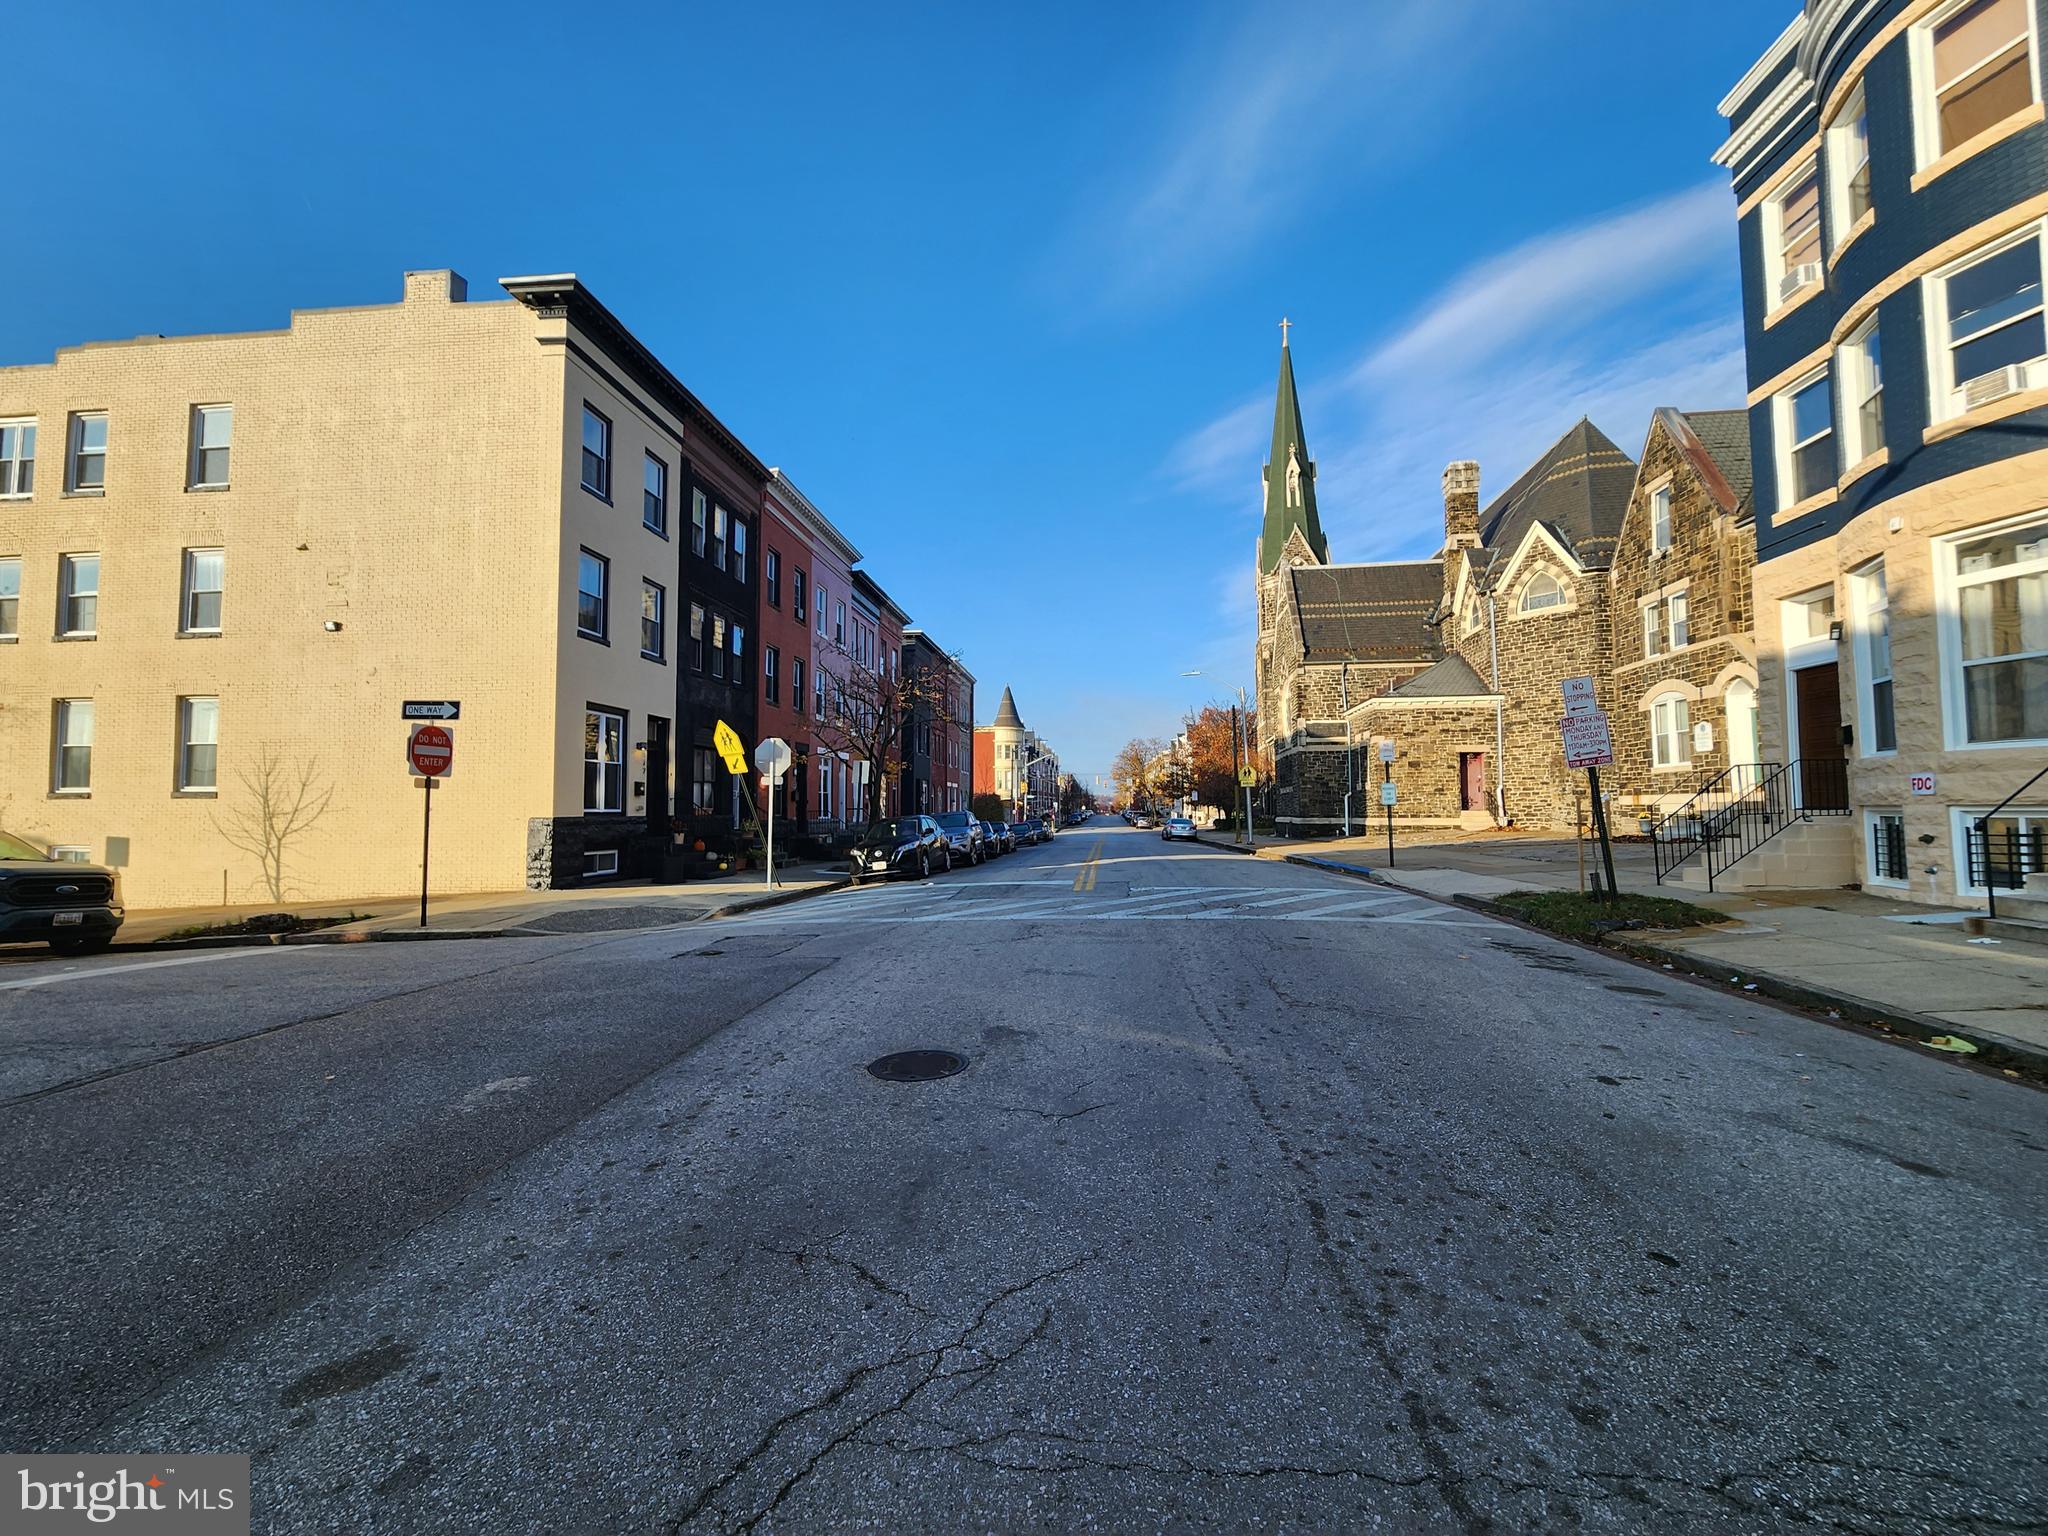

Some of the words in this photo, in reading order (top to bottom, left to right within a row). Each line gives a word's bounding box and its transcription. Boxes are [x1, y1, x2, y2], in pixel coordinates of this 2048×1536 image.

[1572, 682, 1584, 691] NO
[1566, 692, 1594, 703] STOPPING
[408, 706, 424, 714] ONE
[427, 706, 443, 714] WAY
[1562, 718, 1575, 728] NO
[1575, 714, 1605, 726] PARKING
[1565, 724, 1592, 735] MONDAY
[418, 735, 429, 743] DO
[432, 736, 447, 745] NOT
[1570, 730, 1603, 742] THURSDAY
[419, 757, 444, 767] ENTER
[1581, 759, 1597, 767] AWAY
[1911, 776, 1932, 791] FDC
